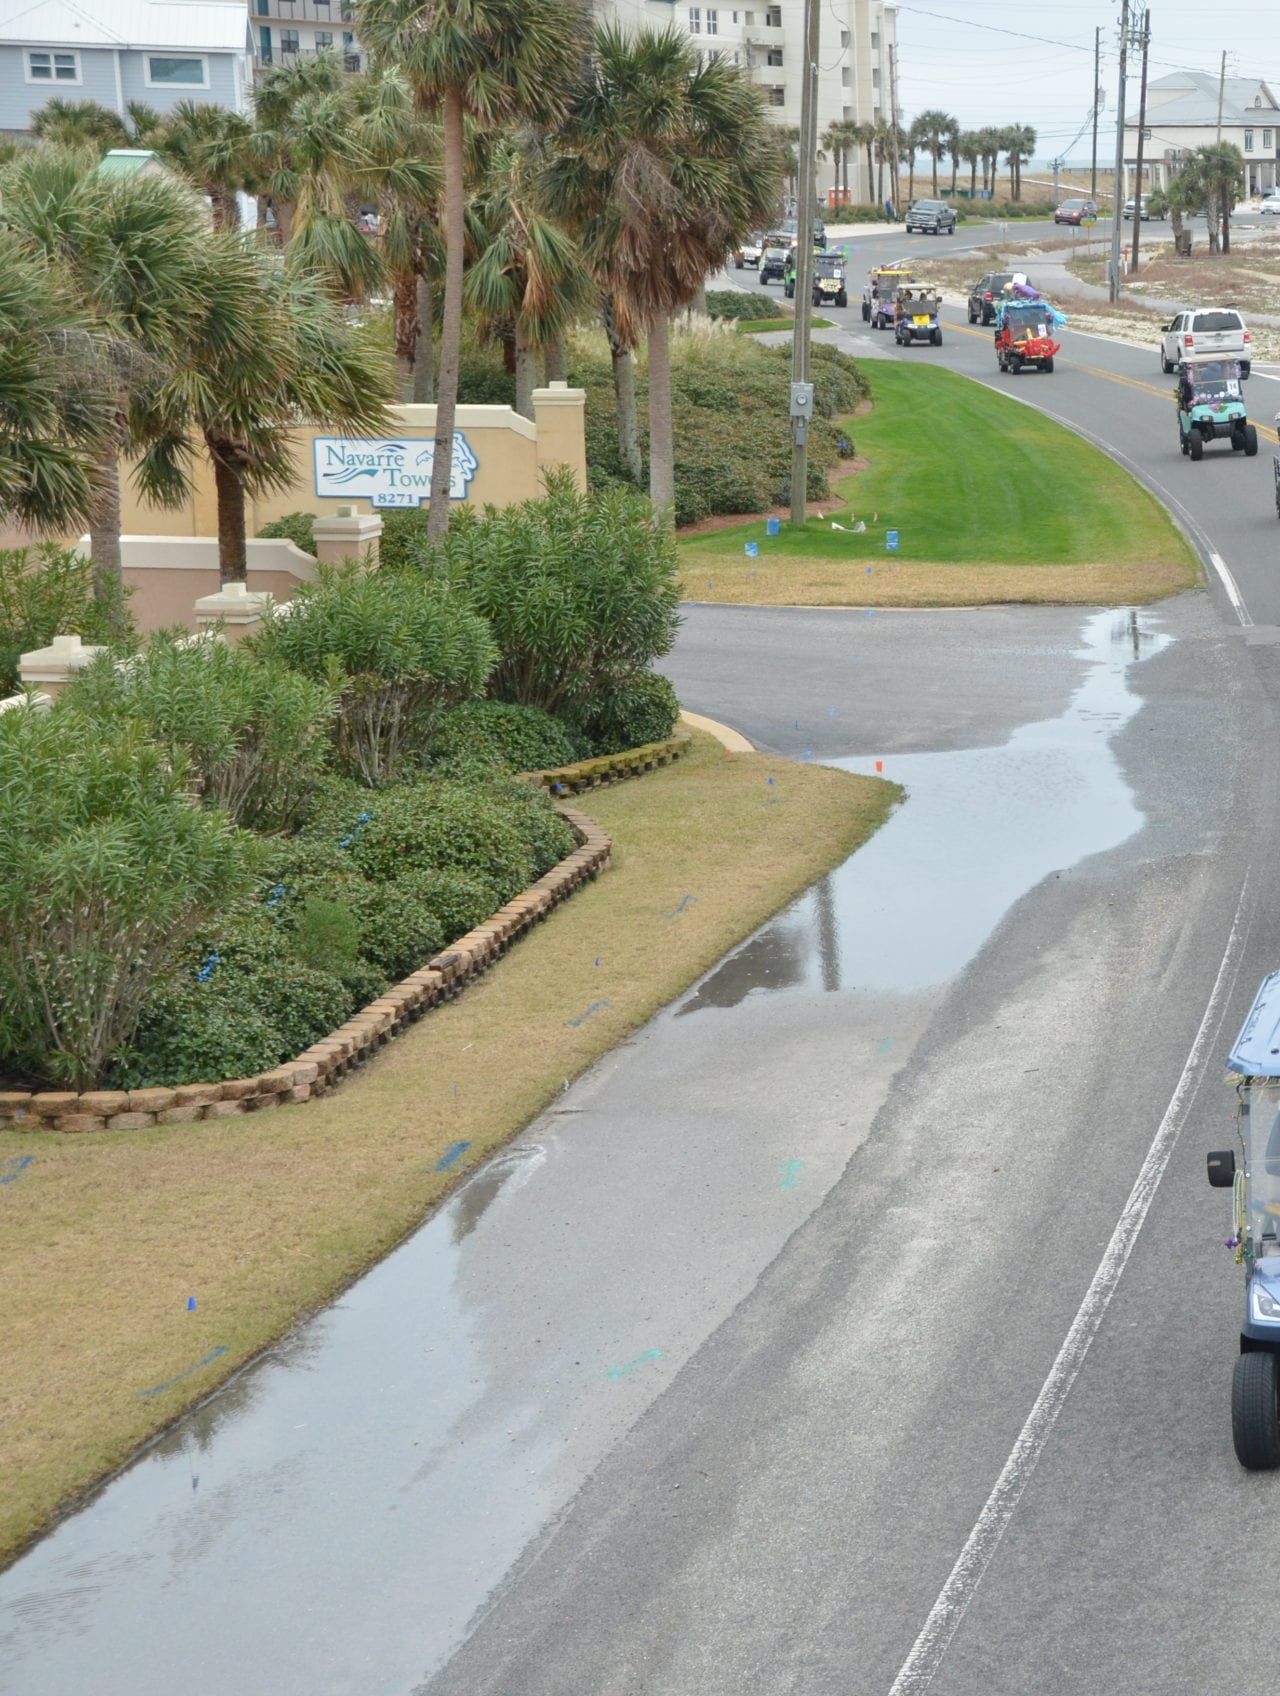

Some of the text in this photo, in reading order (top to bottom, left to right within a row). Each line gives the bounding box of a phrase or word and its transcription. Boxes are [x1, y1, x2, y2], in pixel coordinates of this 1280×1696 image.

[325, 444, 405, 467] Navarre
[382, 468, 456, 487] Tows
[378, 493, 414, 504] 8271
